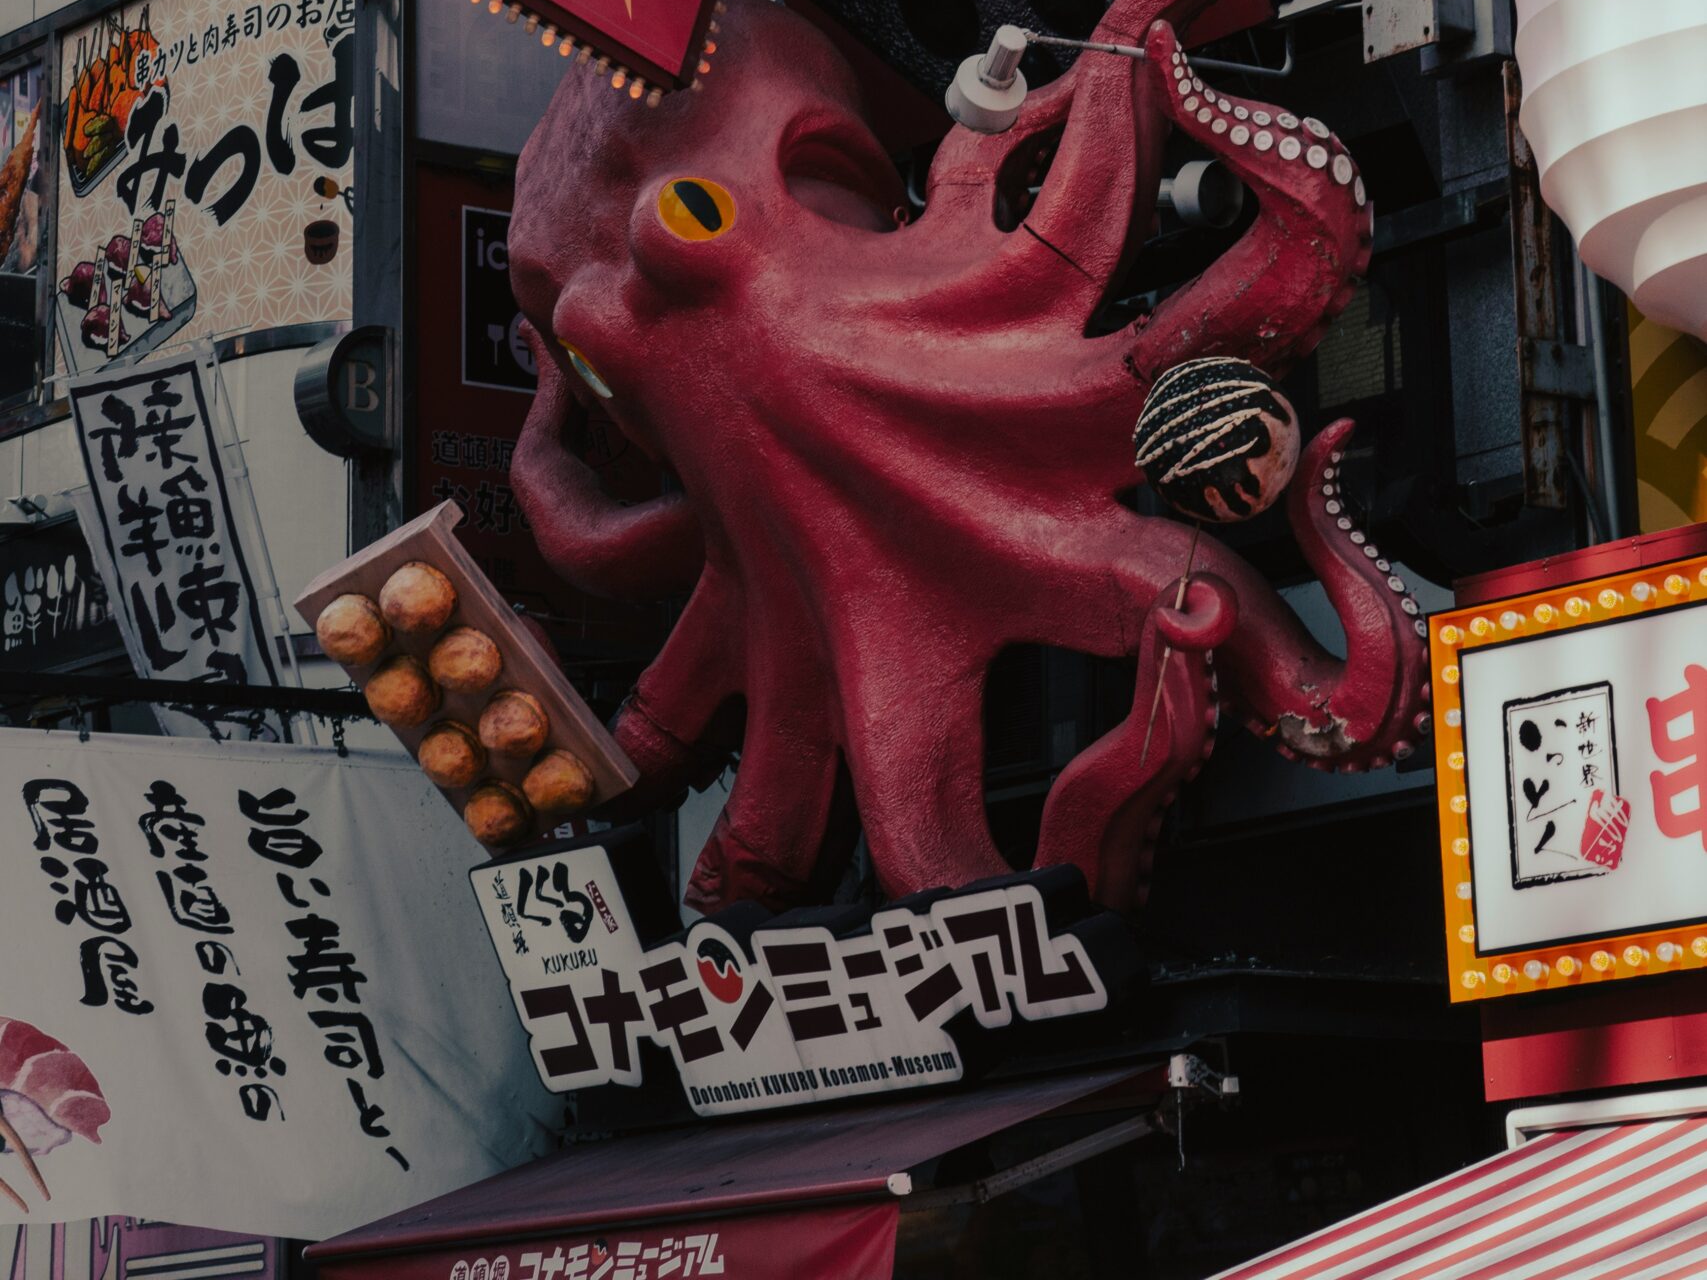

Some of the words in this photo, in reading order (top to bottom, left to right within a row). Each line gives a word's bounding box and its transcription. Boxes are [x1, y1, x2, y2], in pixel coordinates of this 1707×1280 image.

[345, 361, 380, 412] B
[1576, 711, 1603, 787] 新世界
[22, 778, 154, 1015] 居酒屋
[517, 862, 594, 943] くくる
[138, 780, 287, 1122] 産直の魚の
[520, 900, 1097, 1077] コナモンミュージアム
[542, 949, 598, 975] KUKURU
[690, 1077, 762, 1106] Dotonbori
[761, 1069, 819, 1096] KUKURU
[818, 1051, 957, 1088] Konamon-Museum
[519, 1233, 725, 1280] コナモンミュージアム
